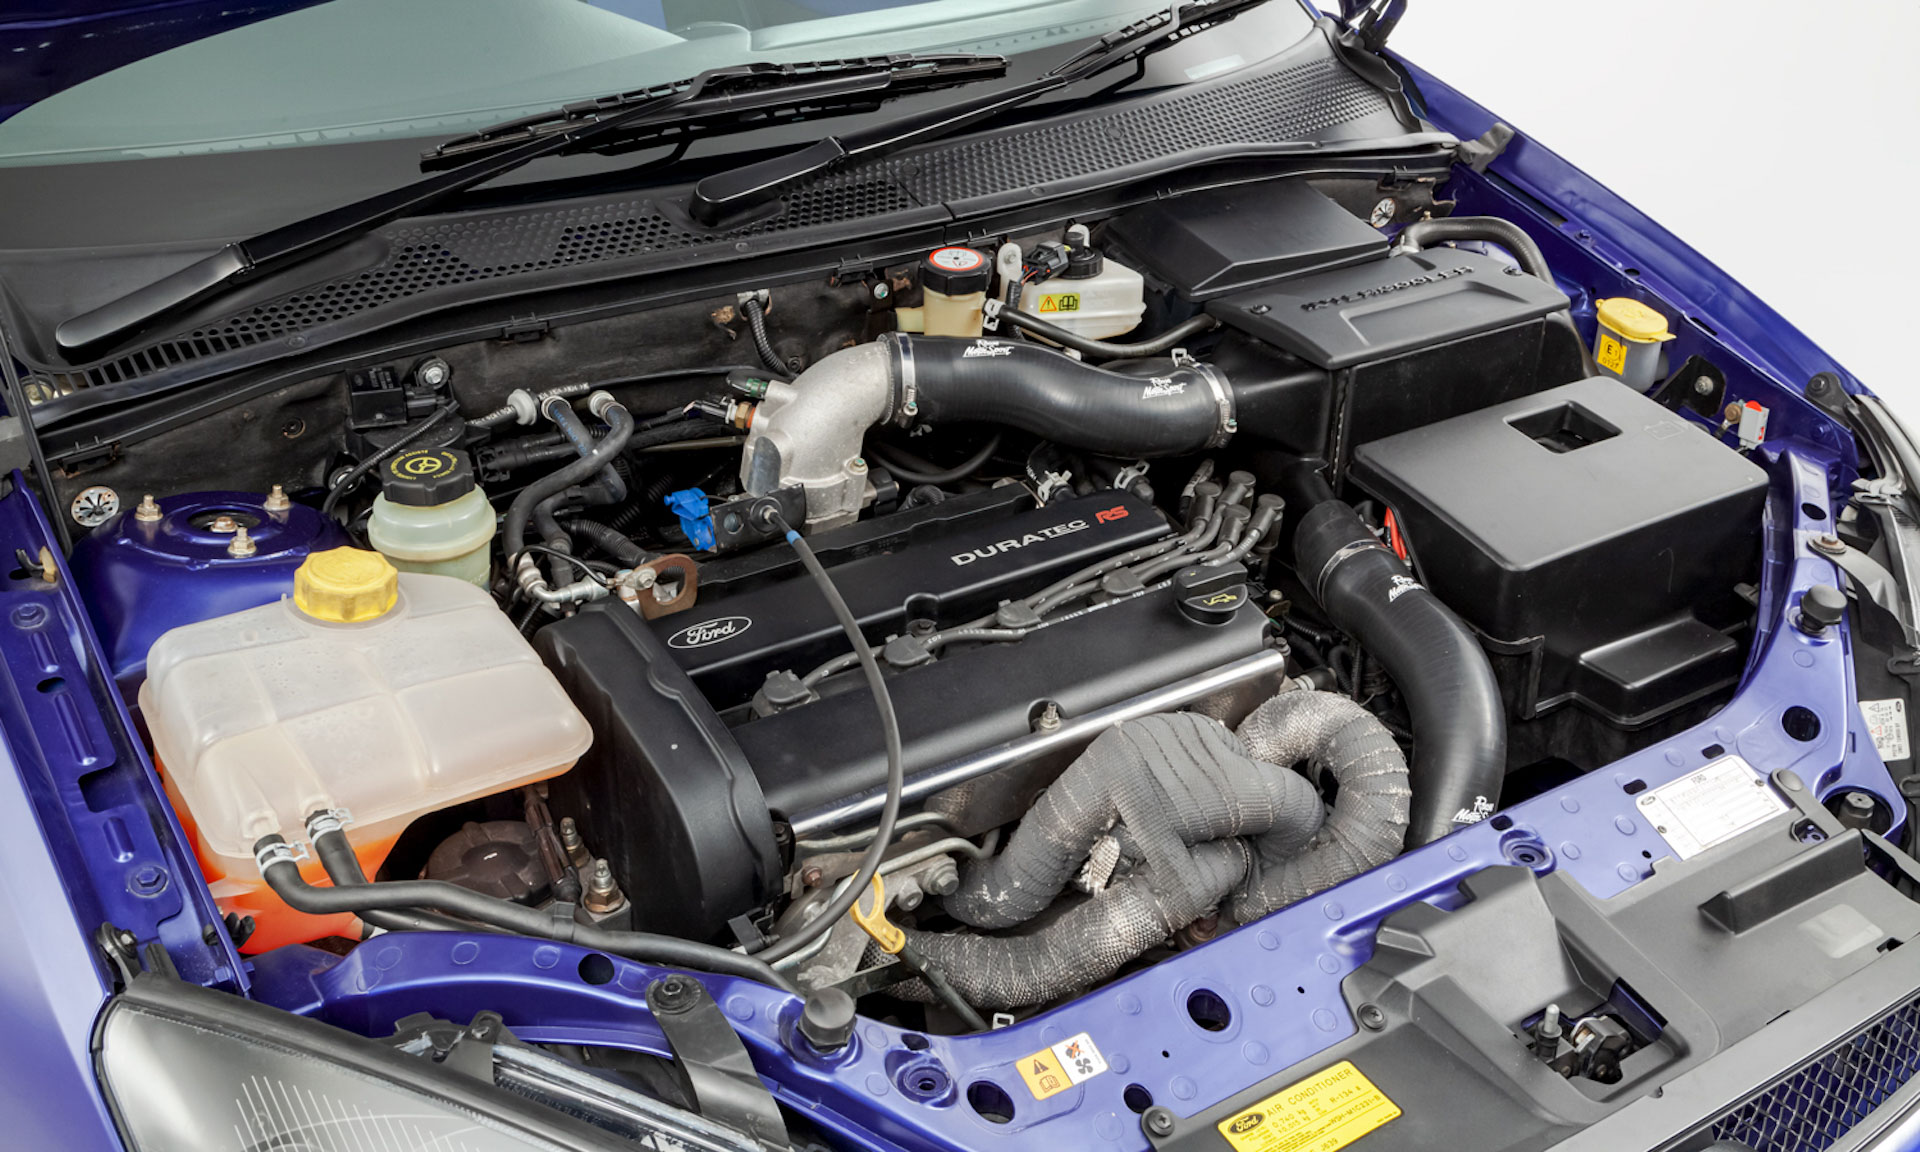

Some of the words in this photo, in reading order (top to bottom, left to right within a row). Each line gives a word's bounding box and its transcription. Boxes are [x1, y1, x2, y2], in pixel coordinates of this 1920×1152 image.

[950, 519, 1090, 566] DURATEC
[1095, 505, 1129, 524] RS
[686, 621, 737, 644] Ford
[1266, 1103, 1284, 1118] AIR
[1288, 1068, 1353, 1105] CONDITIONER
